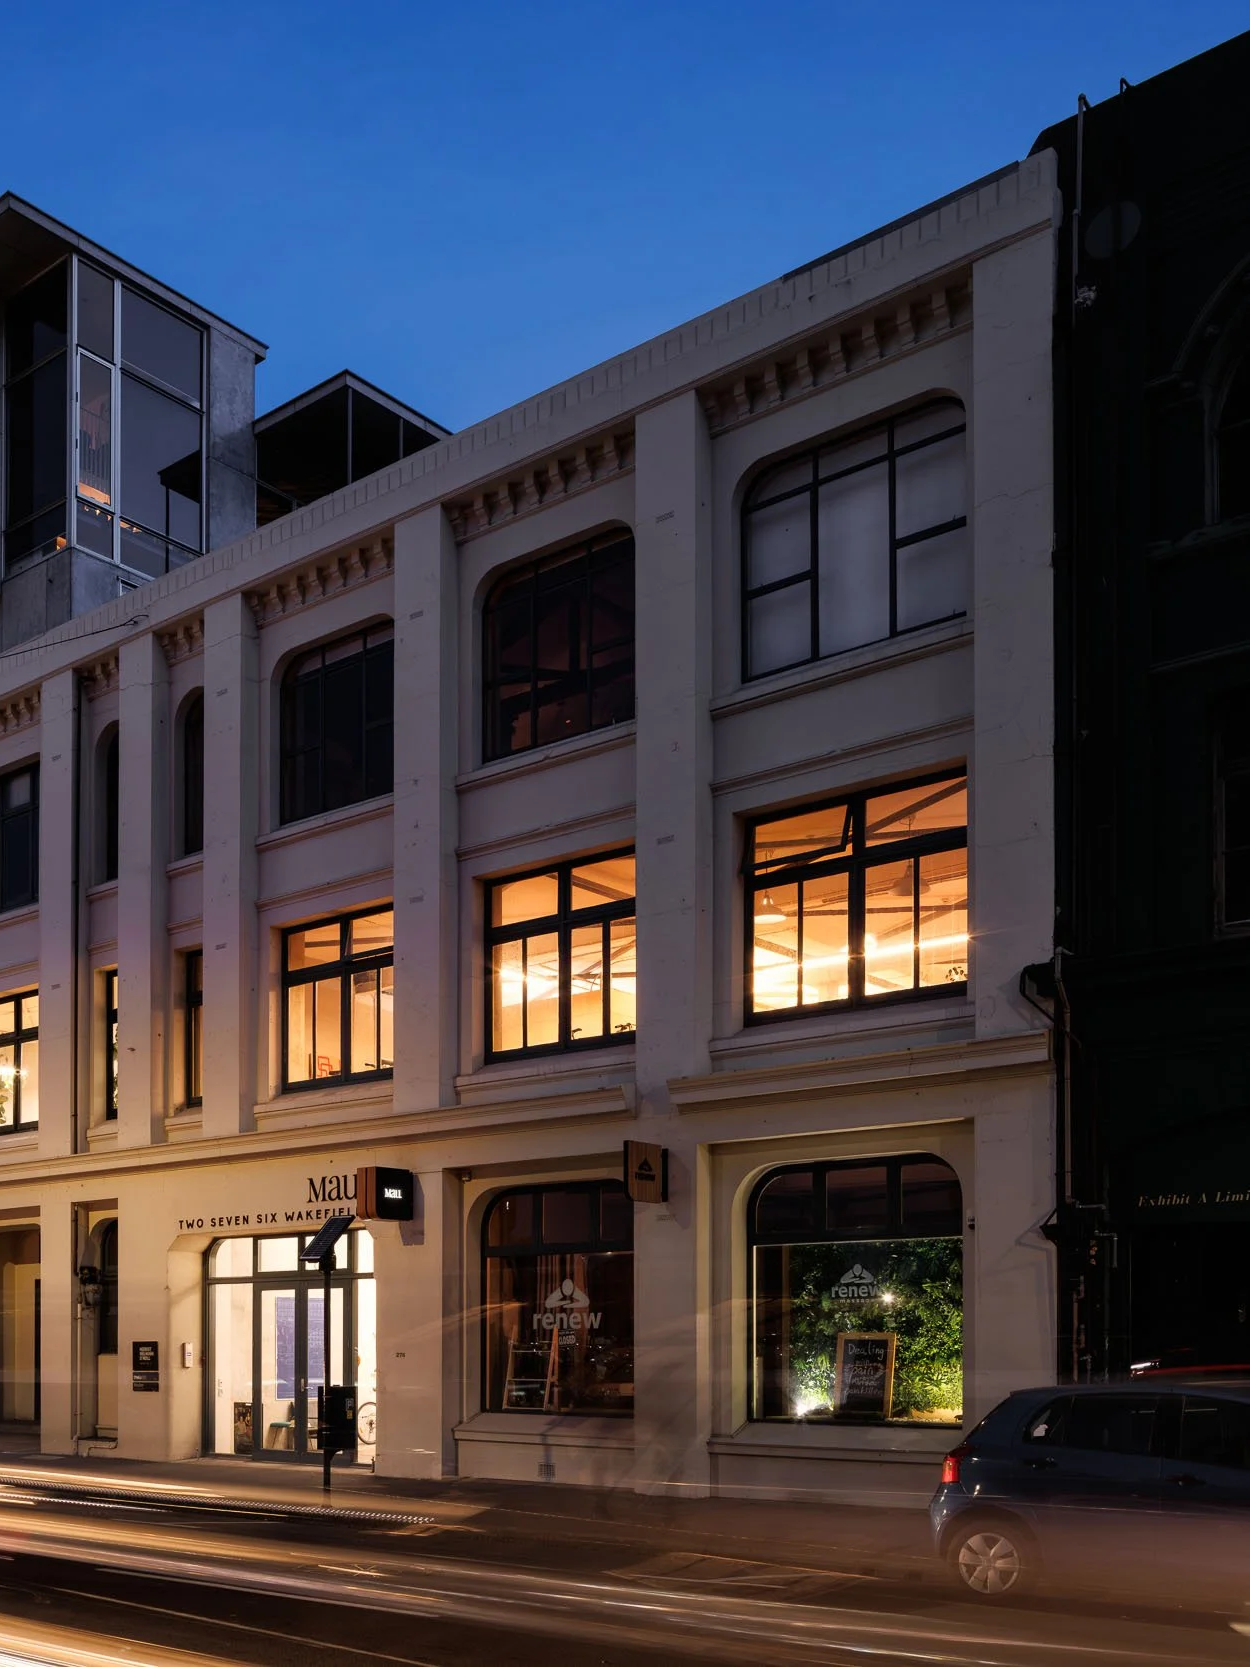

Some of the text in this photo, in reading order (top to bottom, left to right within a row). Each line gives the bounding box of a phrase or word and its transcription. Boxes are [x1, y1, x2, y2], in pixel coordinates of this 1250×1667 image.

[307, 1174, 357, 1203] Mau
[1138, 1194, 1190, 1207] Exhibit
[1198, 1192, 1207, 1204] A
[179, 1207, 359, 1230] TWO SEVEN SIX WAKEFIEL
[831, 1284, 880, 1298] renew
[532, 1312, 602, 1330] renew
